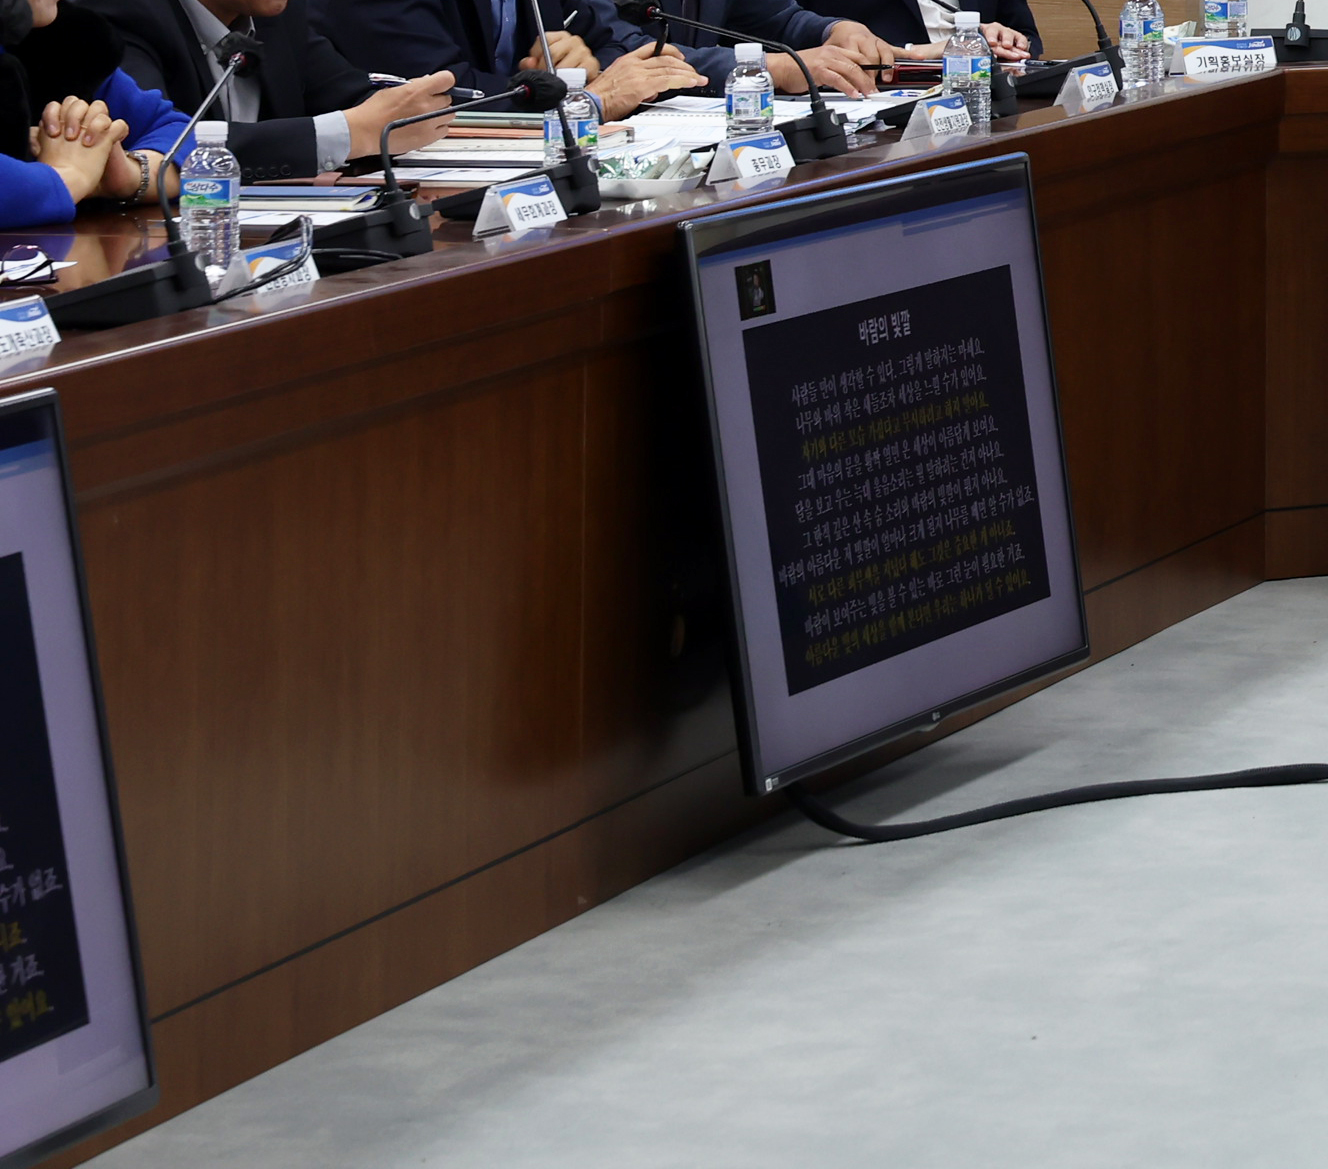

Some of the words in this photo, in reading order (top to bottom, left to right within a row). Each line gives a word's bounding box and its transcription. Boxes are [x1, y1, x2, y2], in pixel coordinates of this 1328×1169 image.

[1196, 53, 1266, 69] 기획홍보실장
[751, 154, 782, 173] 총무과장
[514, 200, 558, 222] 세무회계과장
[858, 314, 890, 346] 바람의
[890, 309, 912, 339] 빛깔
